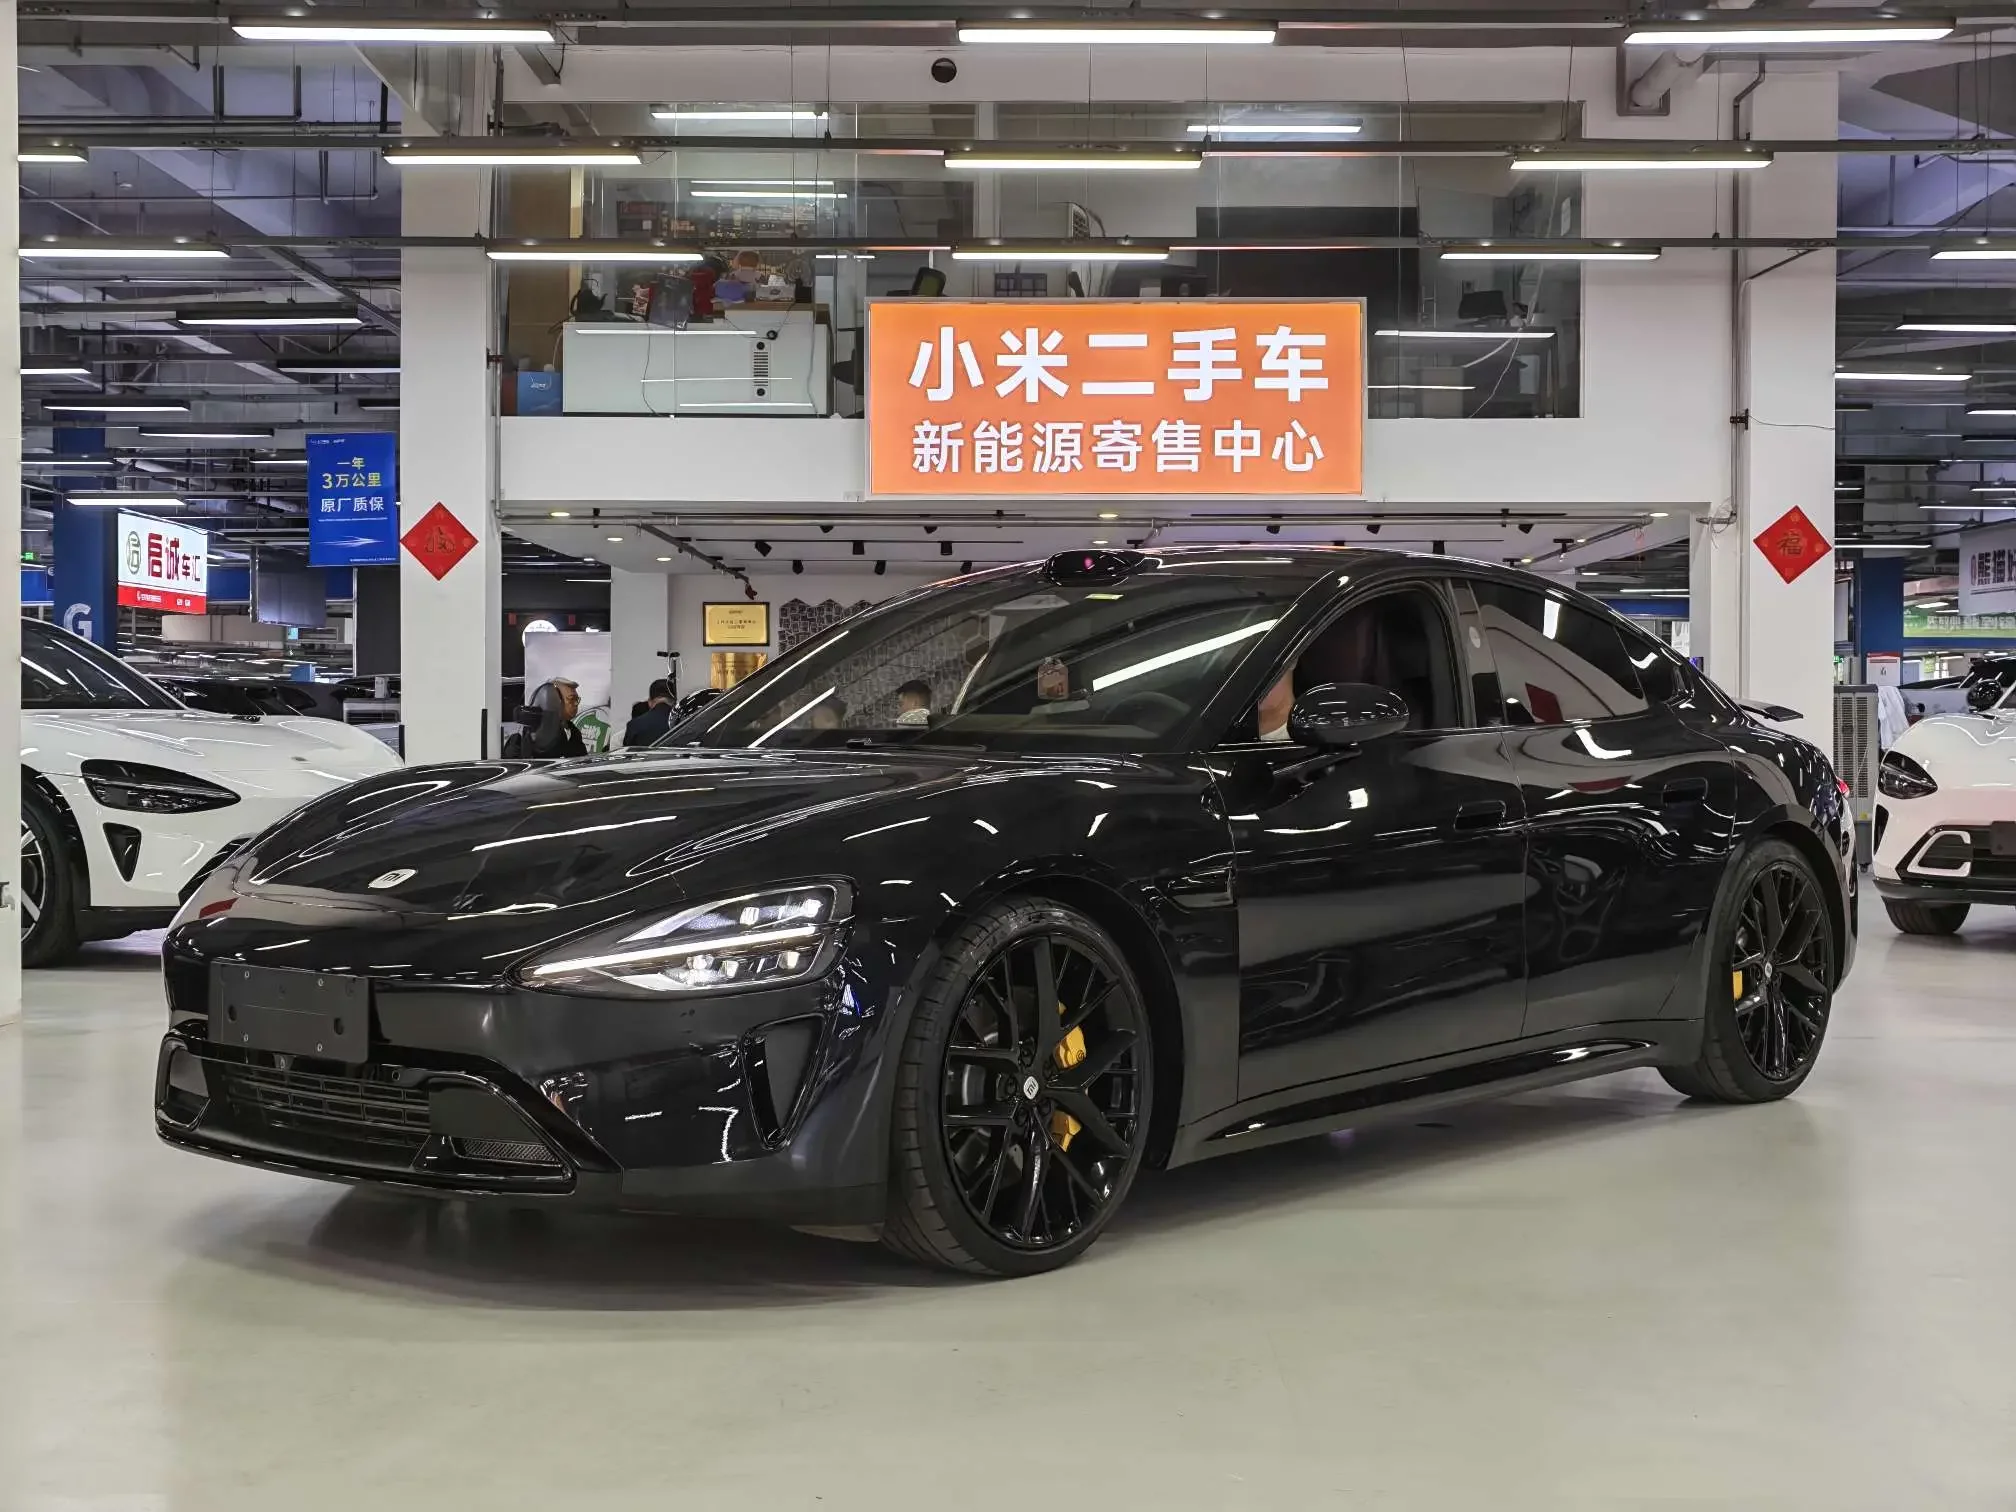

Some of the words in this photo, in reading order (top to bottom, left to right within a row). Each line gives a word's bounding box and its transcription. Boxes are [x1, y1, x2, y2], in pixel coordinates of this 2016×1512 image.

[908, 325, 1329, 402] 小米二手车
[912, 419, 1324, 473] 新能源寄售中心
[337, 456, 366, 470] 一年
[322, 472, 382, 489] 3万公里
[320, 496, 385, 513] 原厂质保
[63, 602, 93, 641] G
